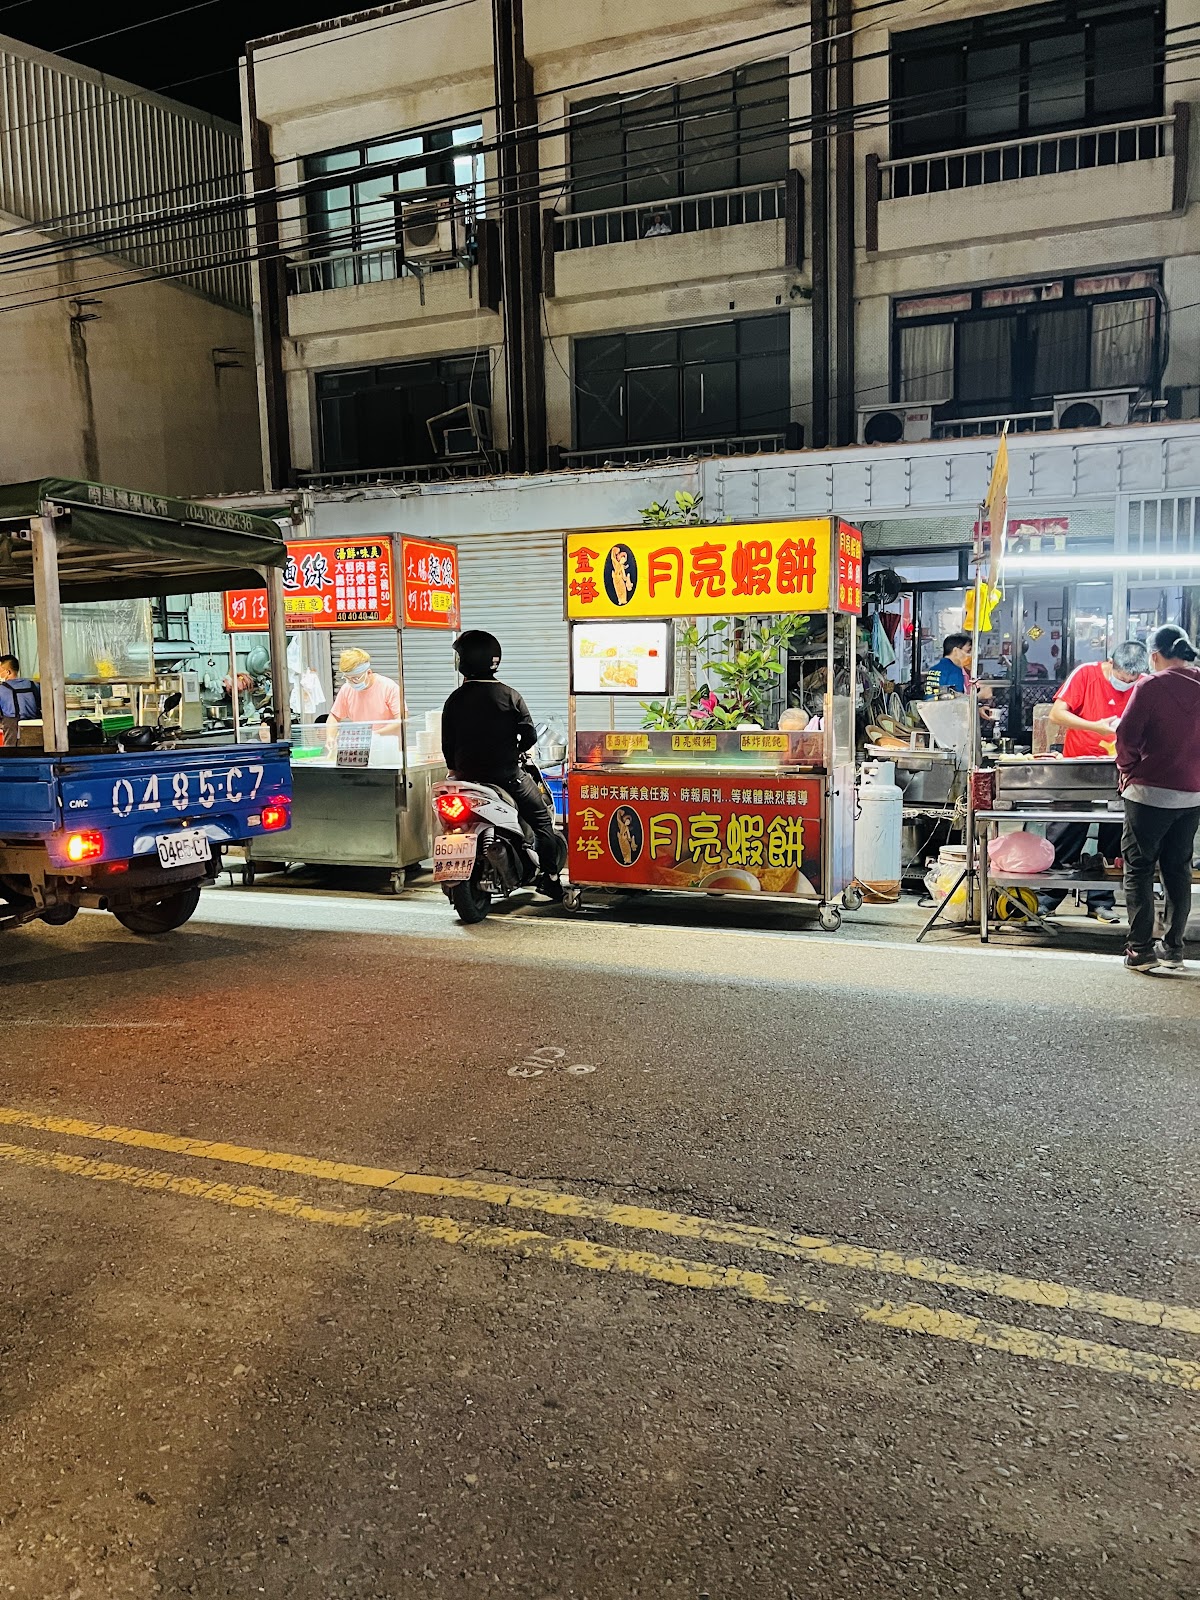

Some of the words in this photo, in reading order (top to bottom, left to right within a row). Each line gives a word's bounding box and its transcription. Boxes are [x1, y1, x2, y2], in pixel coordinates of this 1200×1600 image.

[648, 538, 816, 598] 月亮蝦餅
[231, 596, 267, 619] 蚵仔
[673, 734, 711, 748] 月亮蝦餅
[69, 799, 88, 808] CMC
[649, 811, 805, 868] 月亮蝦餅
